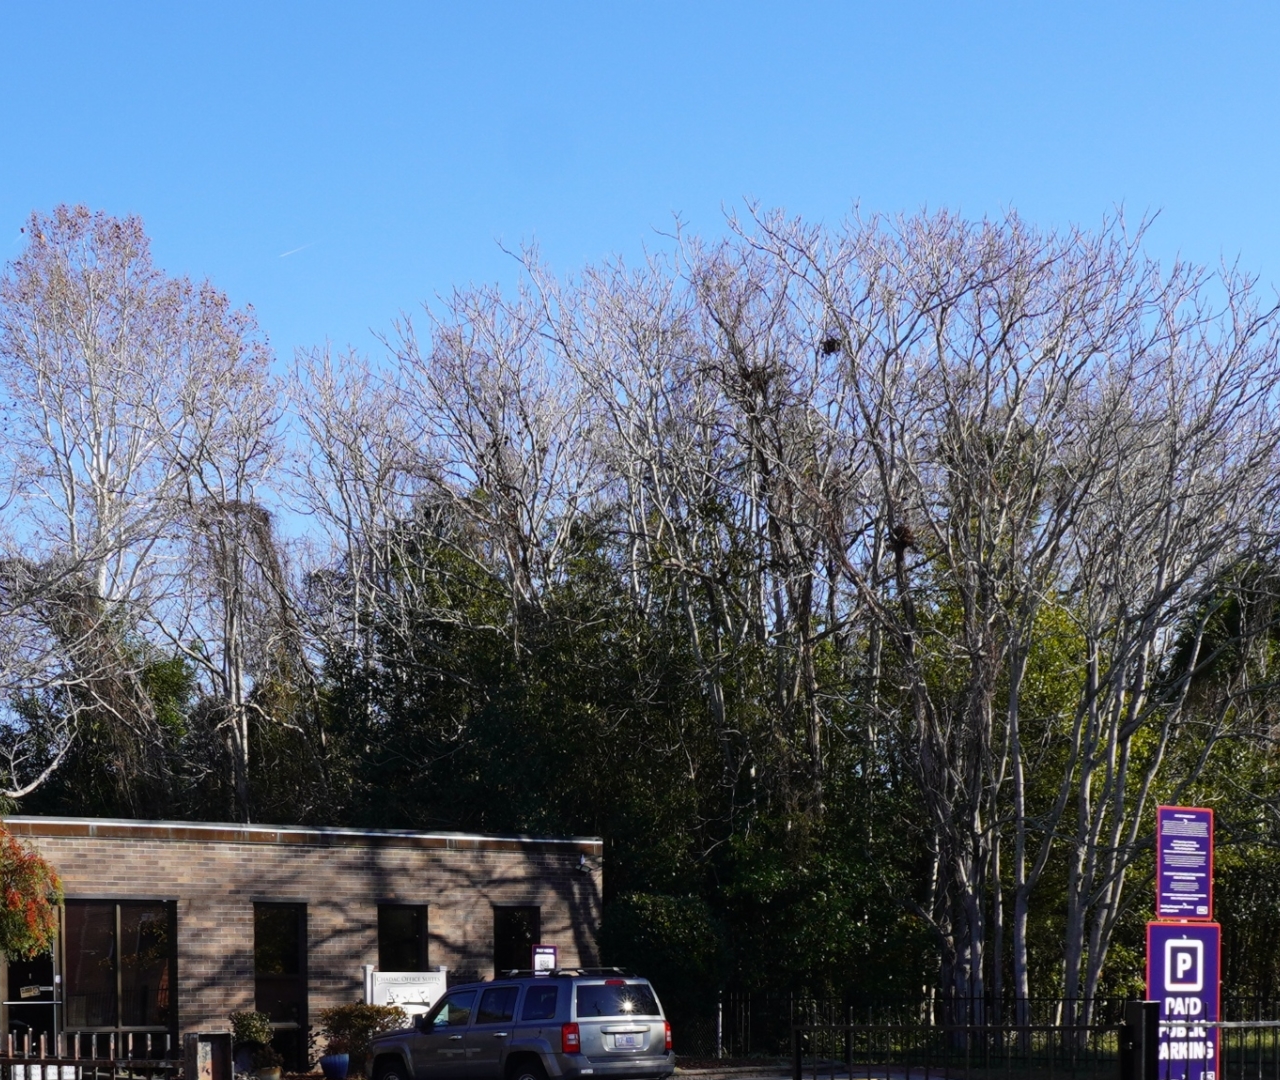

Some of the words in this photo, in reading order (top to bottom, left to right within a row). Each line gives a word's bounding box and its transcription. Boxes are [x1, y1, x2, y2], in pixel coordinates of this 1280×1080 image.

[1177, 952, 1192, 979] P
[401, 975, 420, 983] OFFICE
[422, 975, 441, 983] SUITES
[1165, 997, 1202, 1015] PAID
[1158, 1041, 1214, 1060] ARKING
